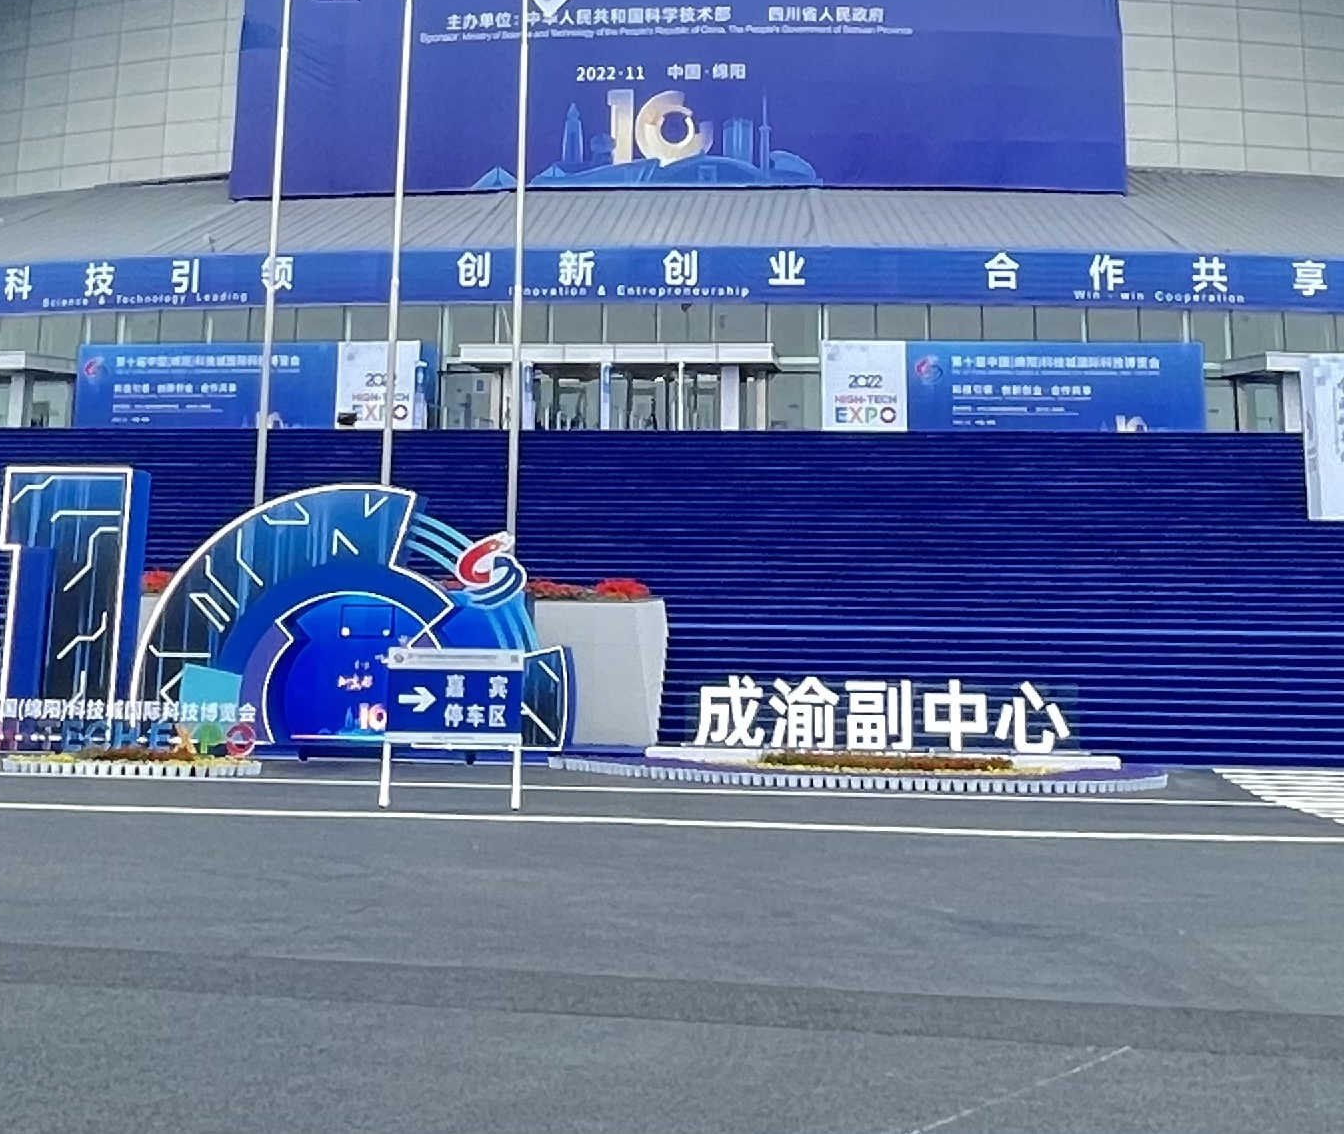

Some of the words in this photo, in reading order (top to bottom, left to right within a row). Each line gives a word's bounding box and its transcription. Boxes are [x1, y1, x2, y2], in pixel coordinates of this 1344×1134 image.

[768, 7, 885, 23] 四川省人民政府
[457, 250, 806, 287] 创新创业
[984, 252, 1329, 296] 合作共享
[508, 286, 588, 297] Inovation
[848, 374, 883, 389] 2022
[834, 394, 897, 404] HIGH-TECH
[834, 406, 896, 424] EXPO
[445, 674, 508, 699] 嘉宾
[444, 703, 507, 728] 停车区
[694, 675, 1071, 754] 成渝副中心
